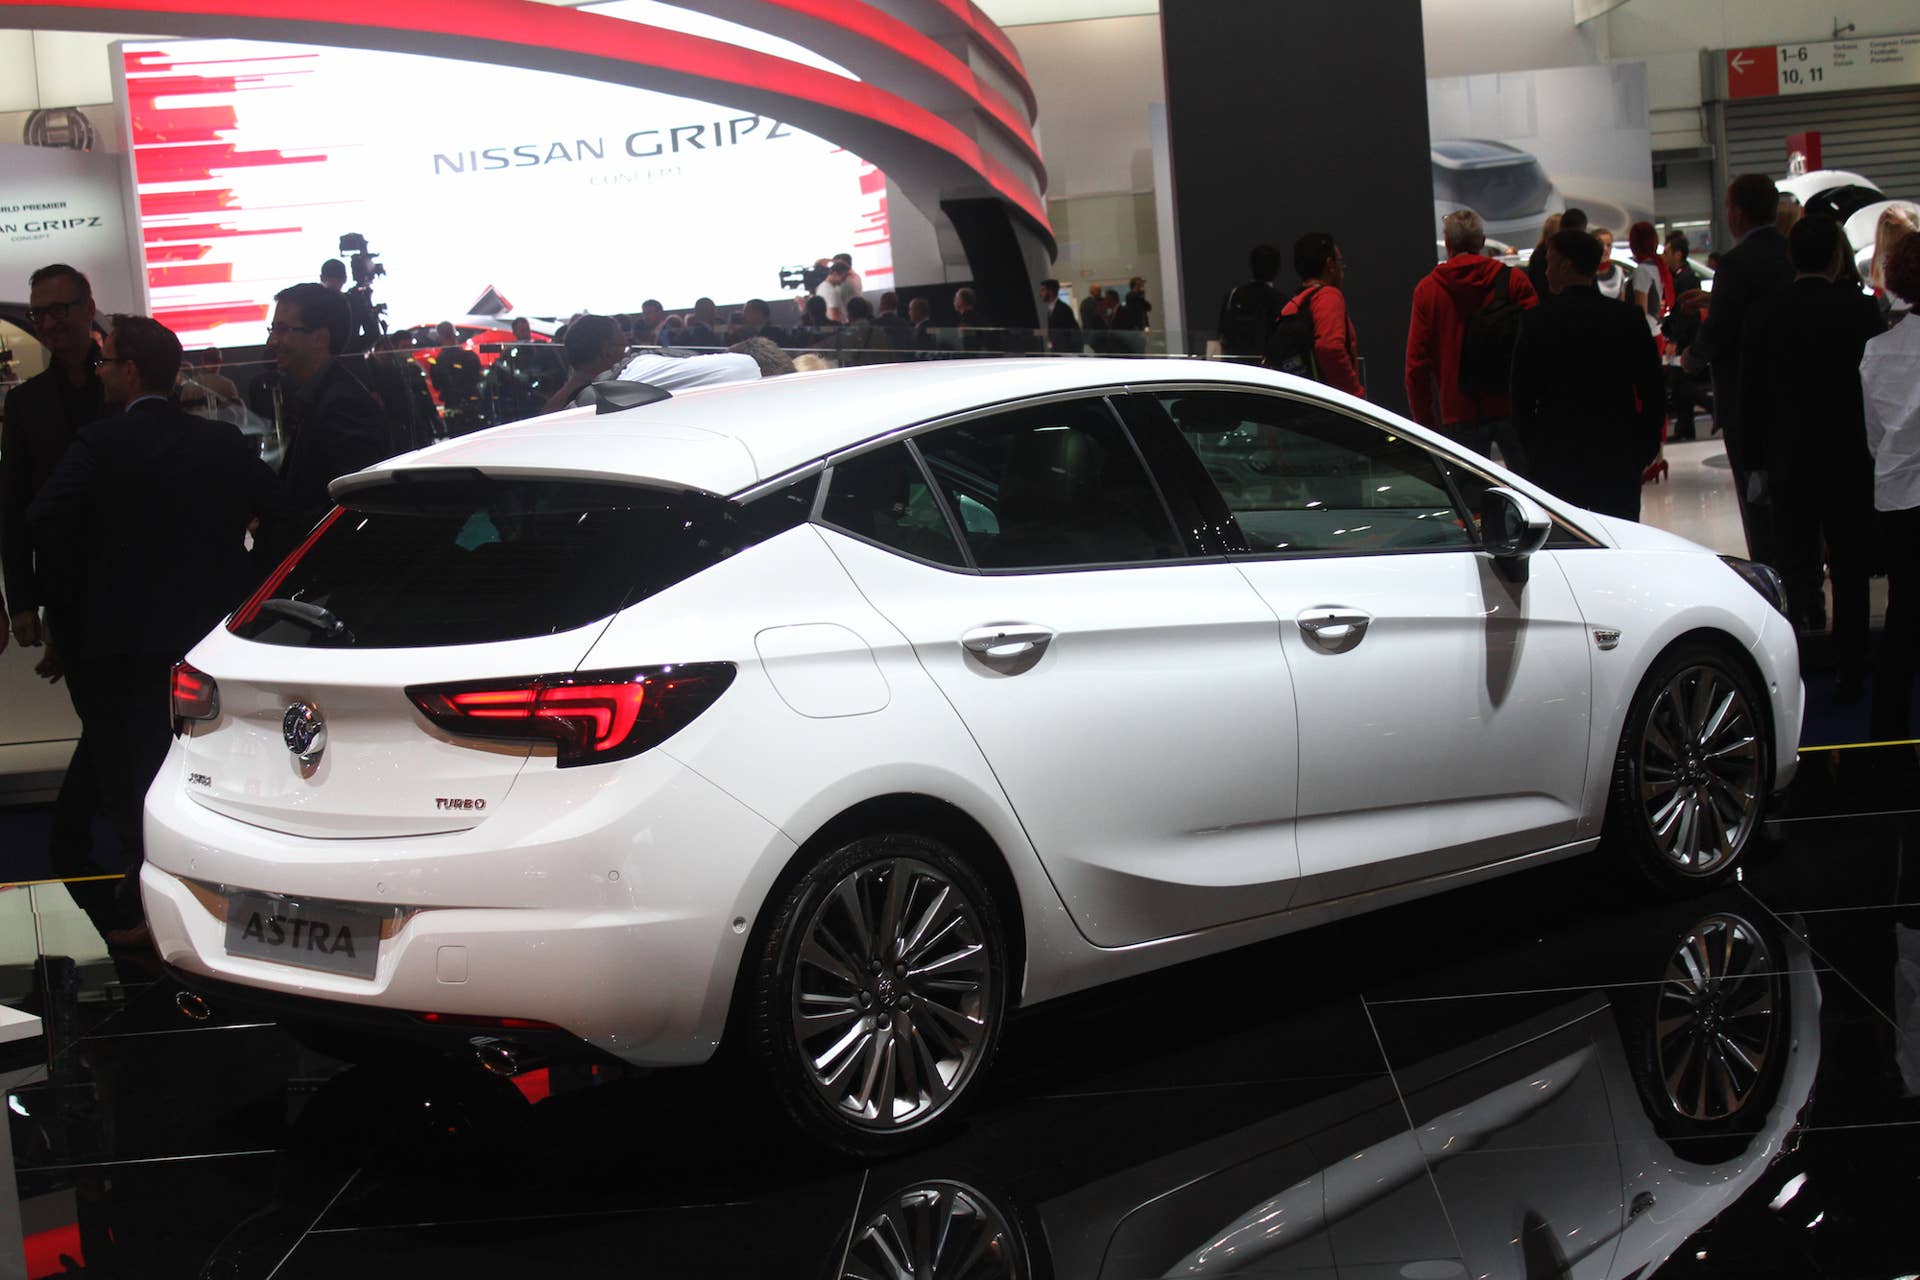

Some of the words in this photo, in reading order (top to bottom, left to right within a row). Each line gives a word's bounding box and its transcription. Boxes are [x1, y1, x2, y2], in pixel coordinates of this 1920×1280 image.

[1782, 68, 1803, 85] 10,
[1809, 67, 1823, 81] 11
[433, 137, 604, 175] NISSAN
[624, 115, 793, 158] GRIPZ
[23, 202, 67, 212] PREMIER
[24, 216, 103, 232] GRIPZ
[435, 797, 487, 811] TURBO
[241, 910, 357, 959] ASTRA
